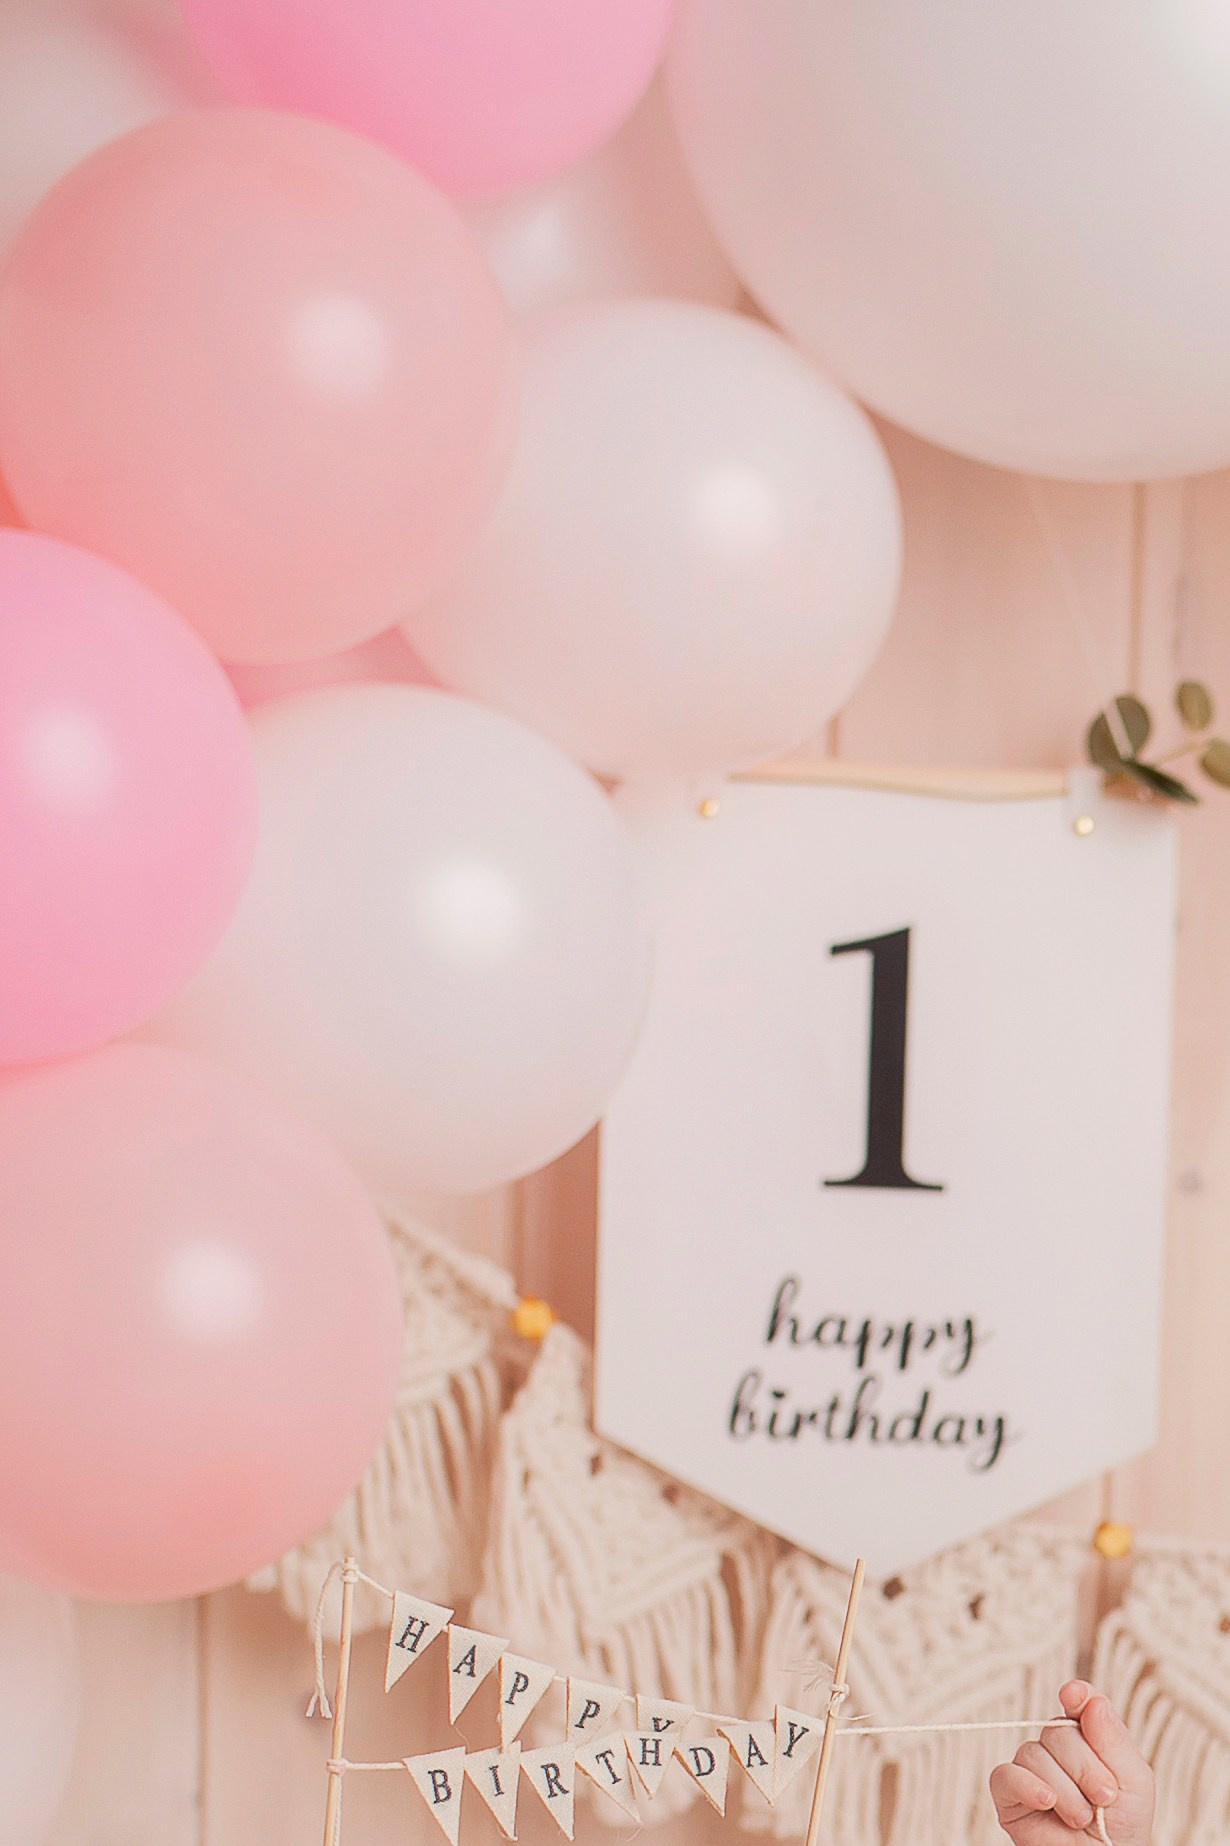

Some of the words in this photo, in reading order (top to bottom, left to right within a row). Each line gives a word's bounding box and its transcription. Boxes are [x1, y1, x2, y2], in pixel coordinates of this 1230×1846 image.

[822, 926, 945, 1193] 1
[764, 1276, 986, 1377] happy
[727, 1369, 1016, 1473] birthday
[428, 1721, 809, 1804] BIRTHDAY
